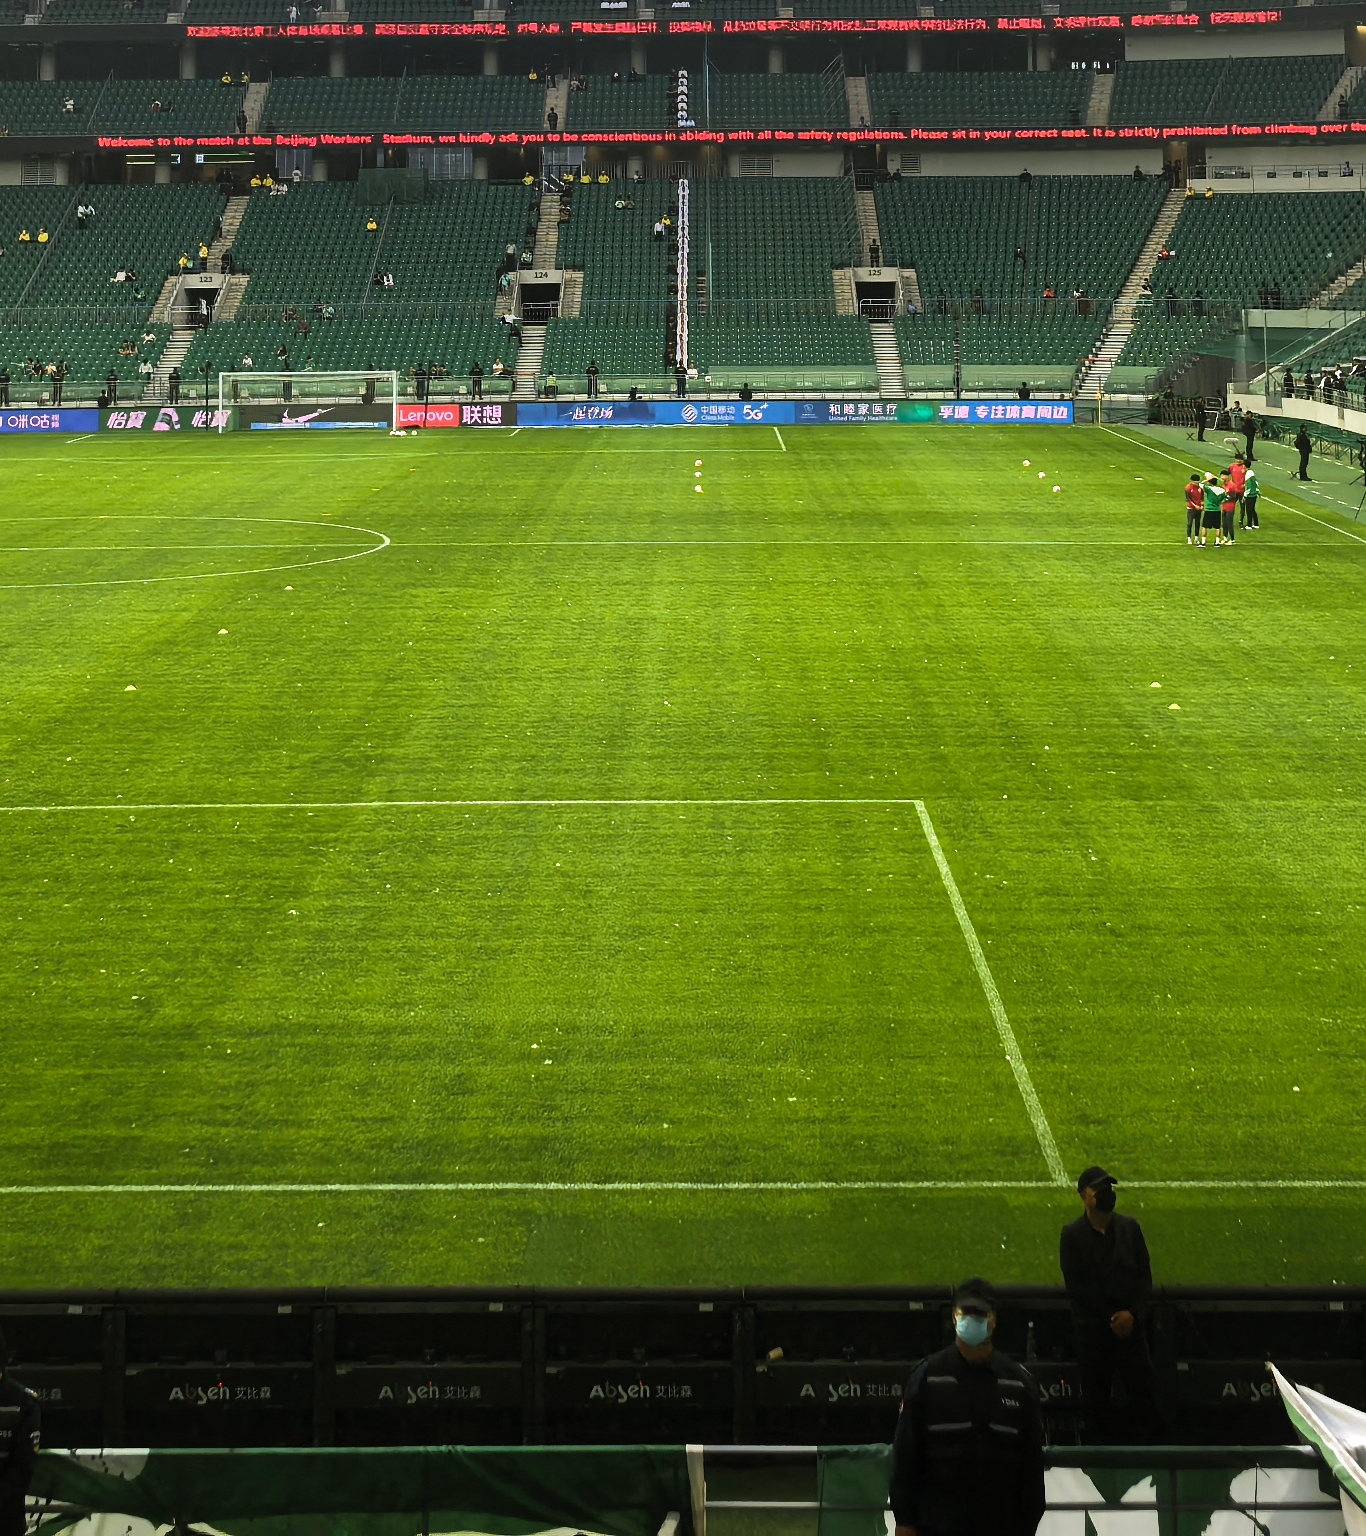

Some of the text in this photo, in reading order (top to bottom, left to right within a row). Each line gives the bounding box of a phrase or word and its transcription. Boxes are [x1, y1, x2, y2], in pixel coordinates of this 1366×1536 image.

[98, 137, 155, 148] Welcome
[157, 137, 171, 147] to
[197, 136, 235, 146] match
[237, 136, 250, 146] at
[275, 134, 318, 147] Beijing
[522, 134, 544, 145] you
[546, 133, 561, 142] to
[563, 132, 579, 142] be
[581, 132, 663, 142] conscientious
[665, 131, 677, 141] in
[679, 130, 724, 143] abiding
[757, 130, 772, 140] all
[911, 128, 948, 140] Please
[969, 129, 981, 139] in
[985, 130, 1012, 141] your
[1015, 129, 1059, 139] correct
[1093, 128, 1103, 138] It
[1105, 129, 1116, 138] is
[1118, 127, 1160, 139] strictly
[1163, 125, 1228, 139] prohibited
[1231, 124, 1262, 135] from
[1265, 123, 1319, 136] climbing
[1321, 123, 1348, 133] over
[199, 276, 213, 284] 123
[533, 271, 548, 279] 124
[867, 268, 882, 277] 125
[399, 406, 454, 422] Lenovo
[461, 405, 502, 425] 联想
[700, 405, 735, 415] 中国移动
[828, 402, 898, 415] 和睦家医疗
[828, 414, 898, 423] United Family Healthcare
[169, 1382, 230, 1405] Absen
[378, 1383, 439, 1405] Asen
[589, 1381, 650, 1405] Absen
[799, 1381, 861, 1402] Asen
